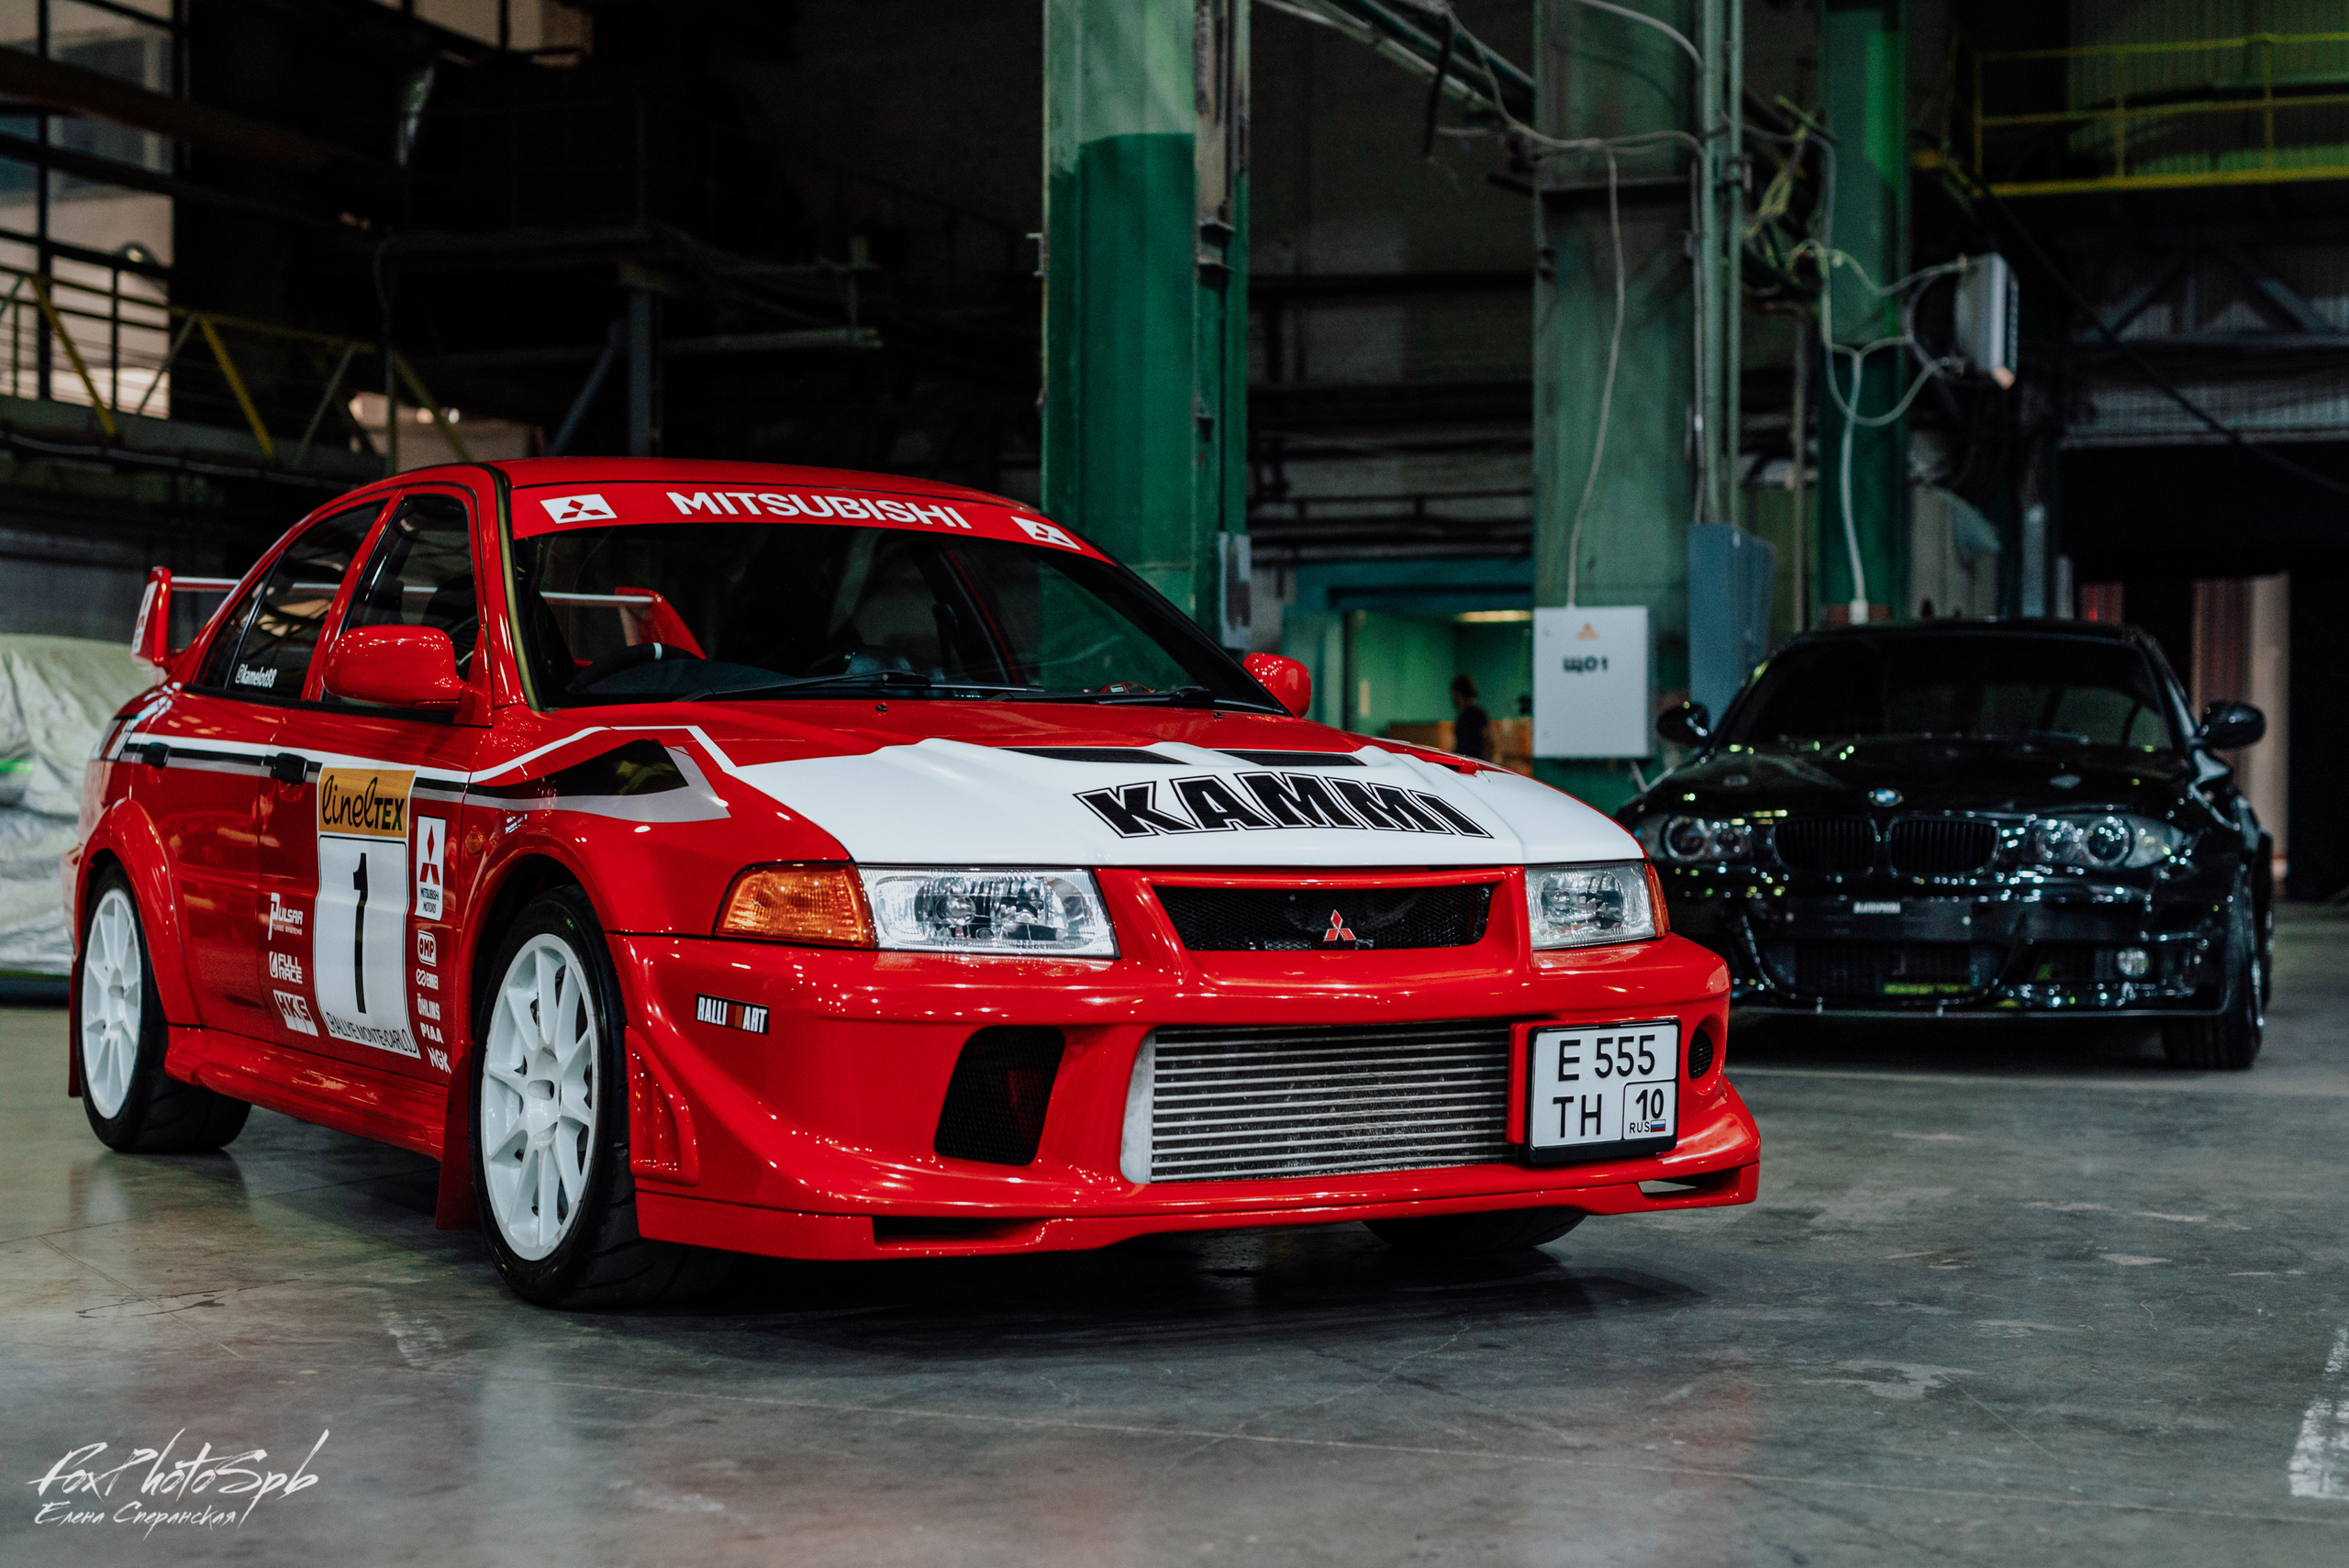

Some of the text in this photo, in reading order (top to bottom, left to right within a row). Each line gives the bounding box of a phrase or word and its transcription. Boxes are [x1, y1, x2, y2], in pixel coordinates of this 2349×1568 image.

[666, 492, 972, 529] MITSUBISHI
[1073, 772, 1495, 839] KAMMI
[420, 887, 440, 901] MITSUBISHI
[268, 892, 304, 940] PULSAR
[353, 852, 368, 1014] 1
[278, 952, 302, 970] FULL
[418, 939, 435, 959] OMP
[278, 966, 303, 984] RACE
[326, 1011, 360, 1040] RALLYE
[420, 1022, 444, 1044] PIAA
[427, 1046, 451, 1074] NGK
[1558, 1034, 1655, 1082] E 555
[1553, 1094, 1602, 1138] TH
[1636, 1088, 1664, 1120] 10
[1629, 1121, 1650, 1134] RUS
